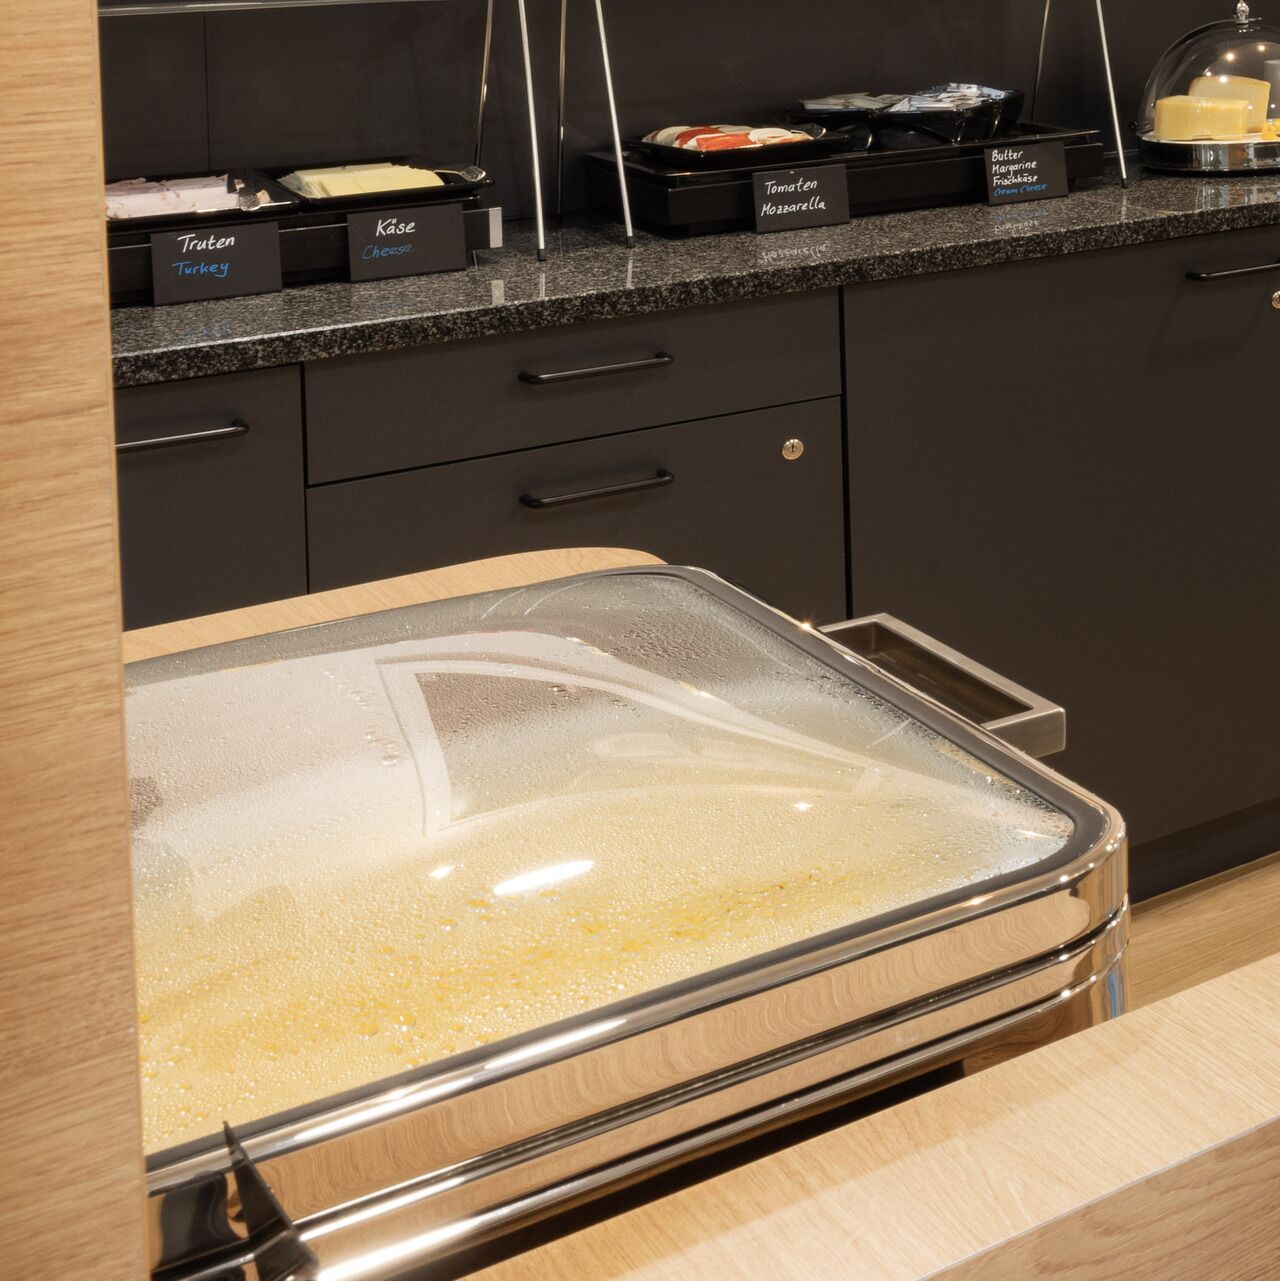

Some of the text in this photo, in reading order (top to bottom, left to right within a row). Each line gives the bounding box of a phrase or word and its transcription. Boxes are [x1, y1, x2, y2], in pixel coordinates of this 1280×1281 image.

[991, 149, 1024, 162] Butter
[992, 161, 1038, 178] Margarine
[765, 177, 818, 195] Tomaten
[993, 173, 1038, 187] Frischkäse
[761, 195, 827, 217] Mozzarella
[375, 218, 416, 237] Käse
[177, 233, 235, 253] Truten
[362, 244, 413, 260] Cheese
[172, 261, 230, 278] Turkey
